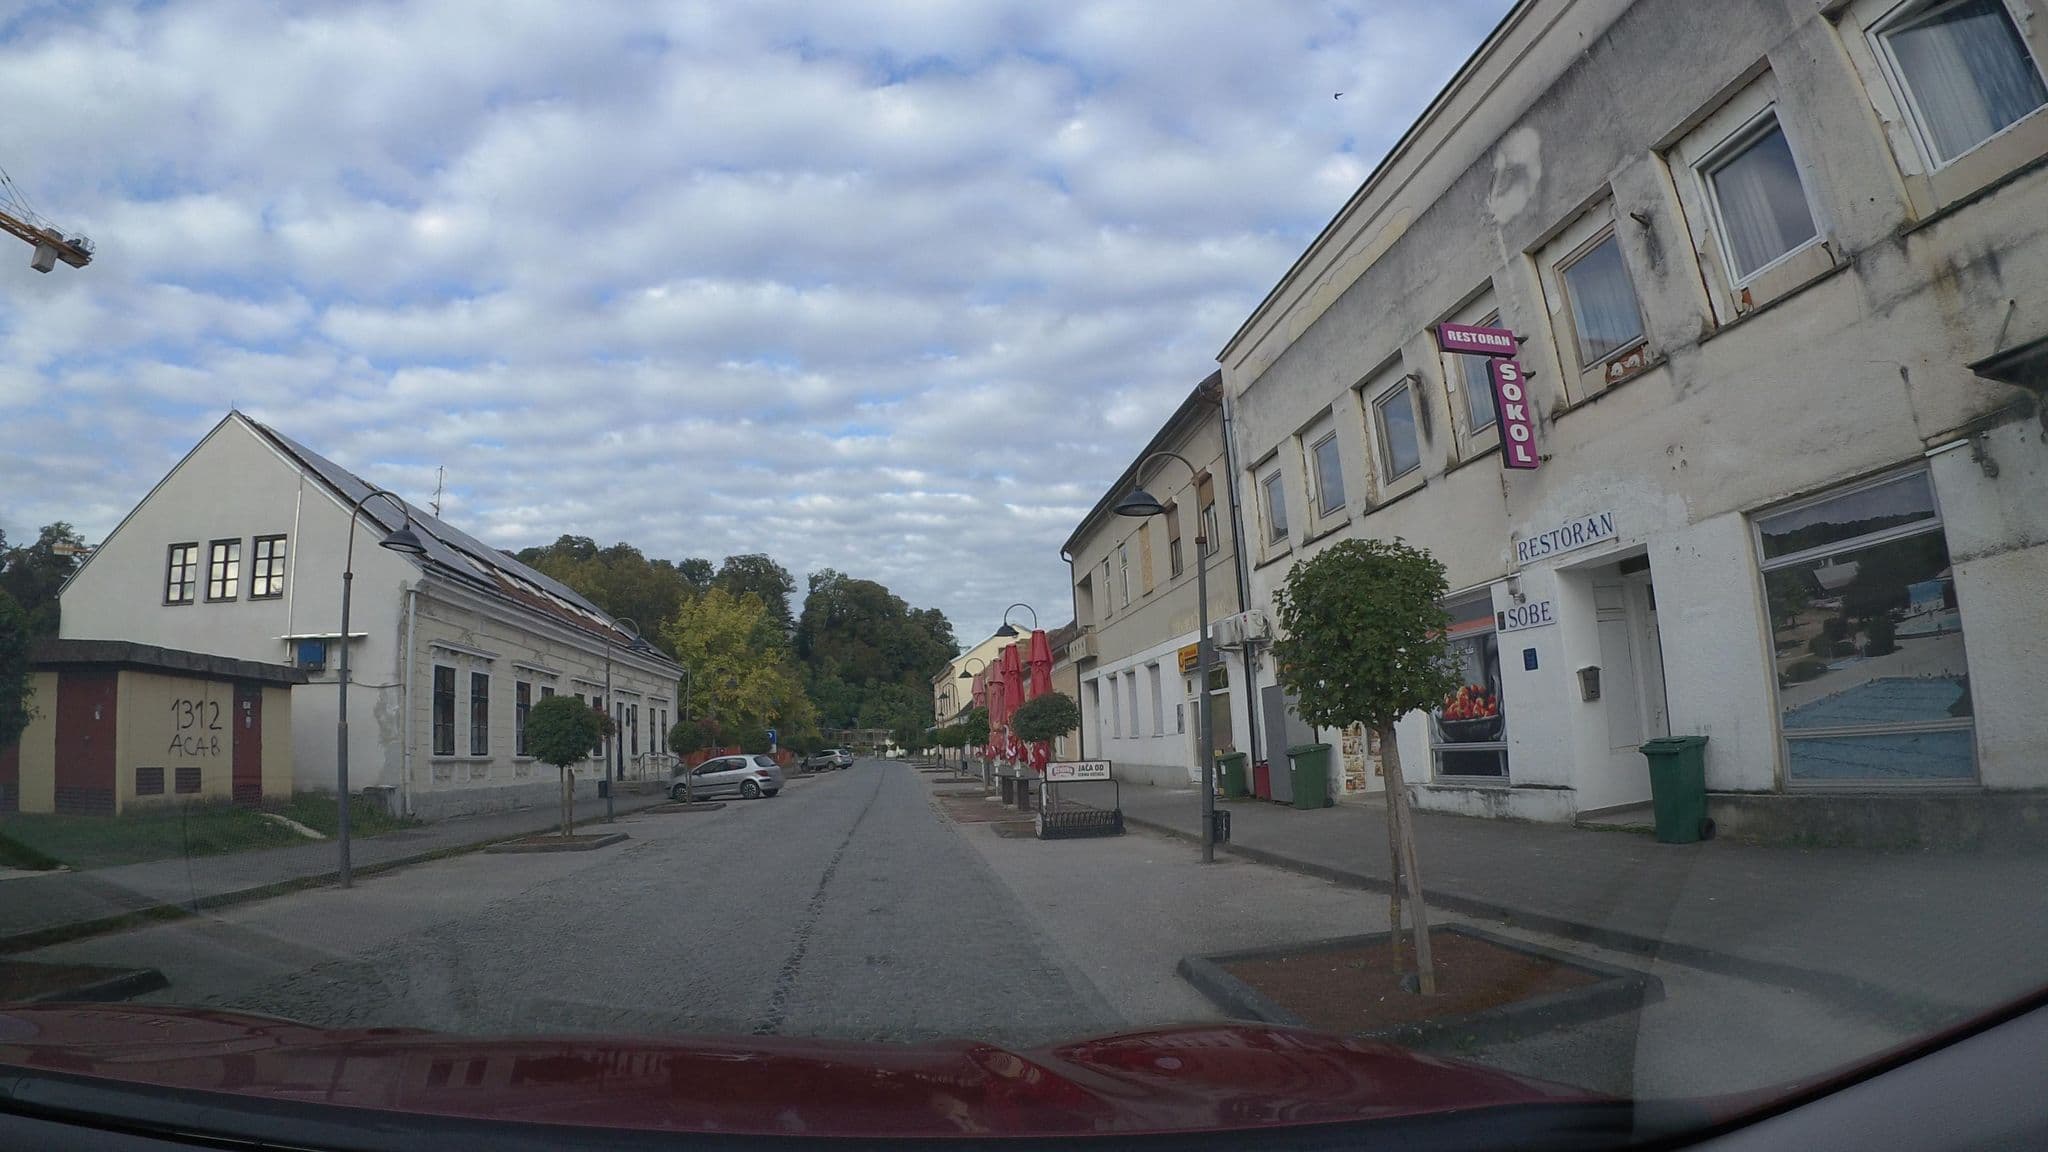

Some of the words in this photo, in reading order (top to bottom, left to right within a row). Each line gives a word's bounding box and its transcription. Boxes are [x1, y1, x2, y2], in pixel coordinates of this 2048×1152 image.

[1447, 330, 1511, 346] RESTORAN
[1499, 363, 1532, 463] SOKOL
[1518, 511, 1613, 561] RESTORAN
[1508, 600, 1552, 628] SOBE
[171, 699, 222, 731] 1312
